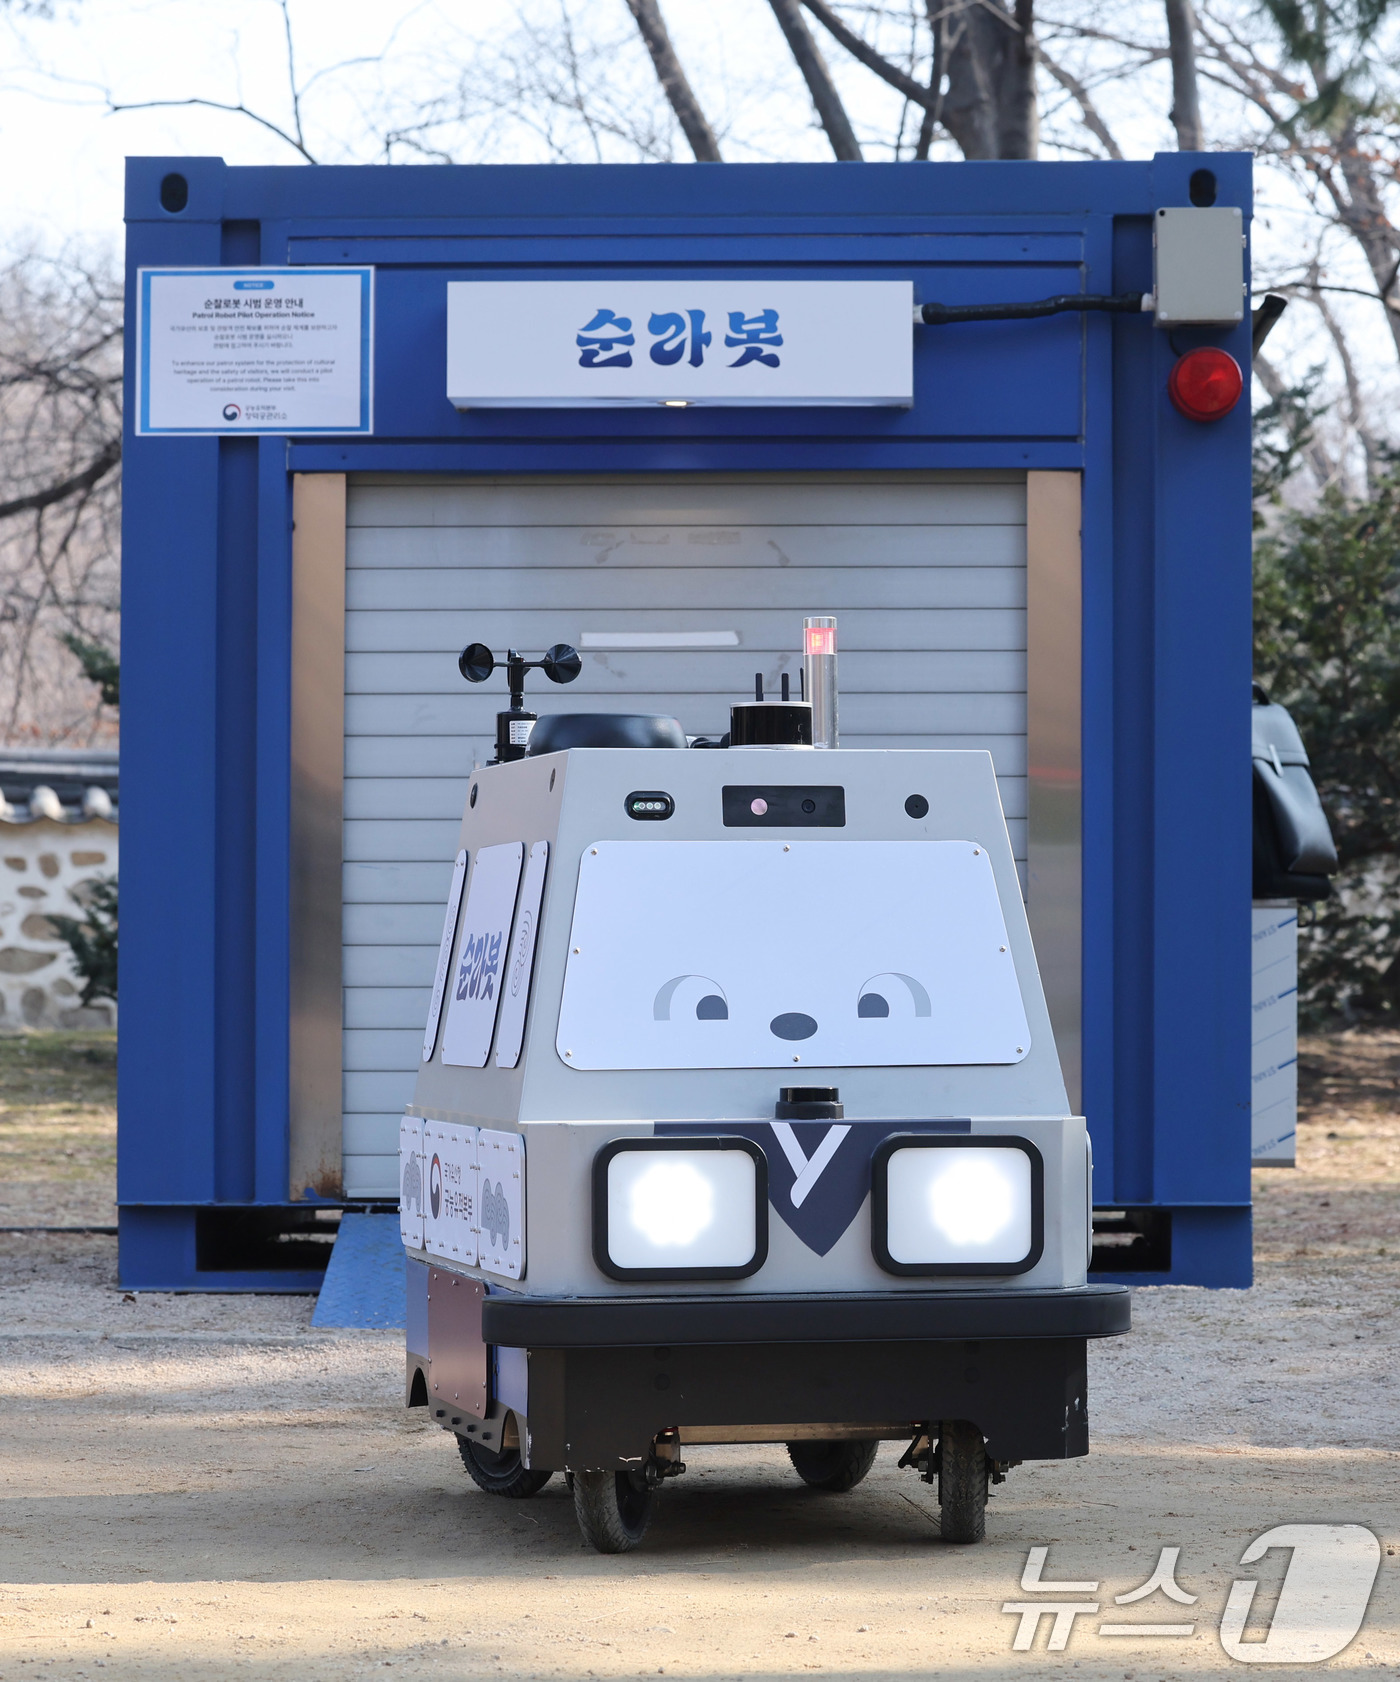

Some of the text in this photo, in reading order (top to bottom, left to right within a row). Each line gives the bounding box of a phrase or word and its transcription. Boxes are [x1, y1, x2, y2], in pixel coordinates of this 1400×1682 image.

[204, 298, 304, 310] 순찰로봇 시범 운영 안내
[255, 311, 290, 319] Operation
[576, 308, 784, 368] 순라봇
[444, 1189, 473, 1222] 궁능유적본부
